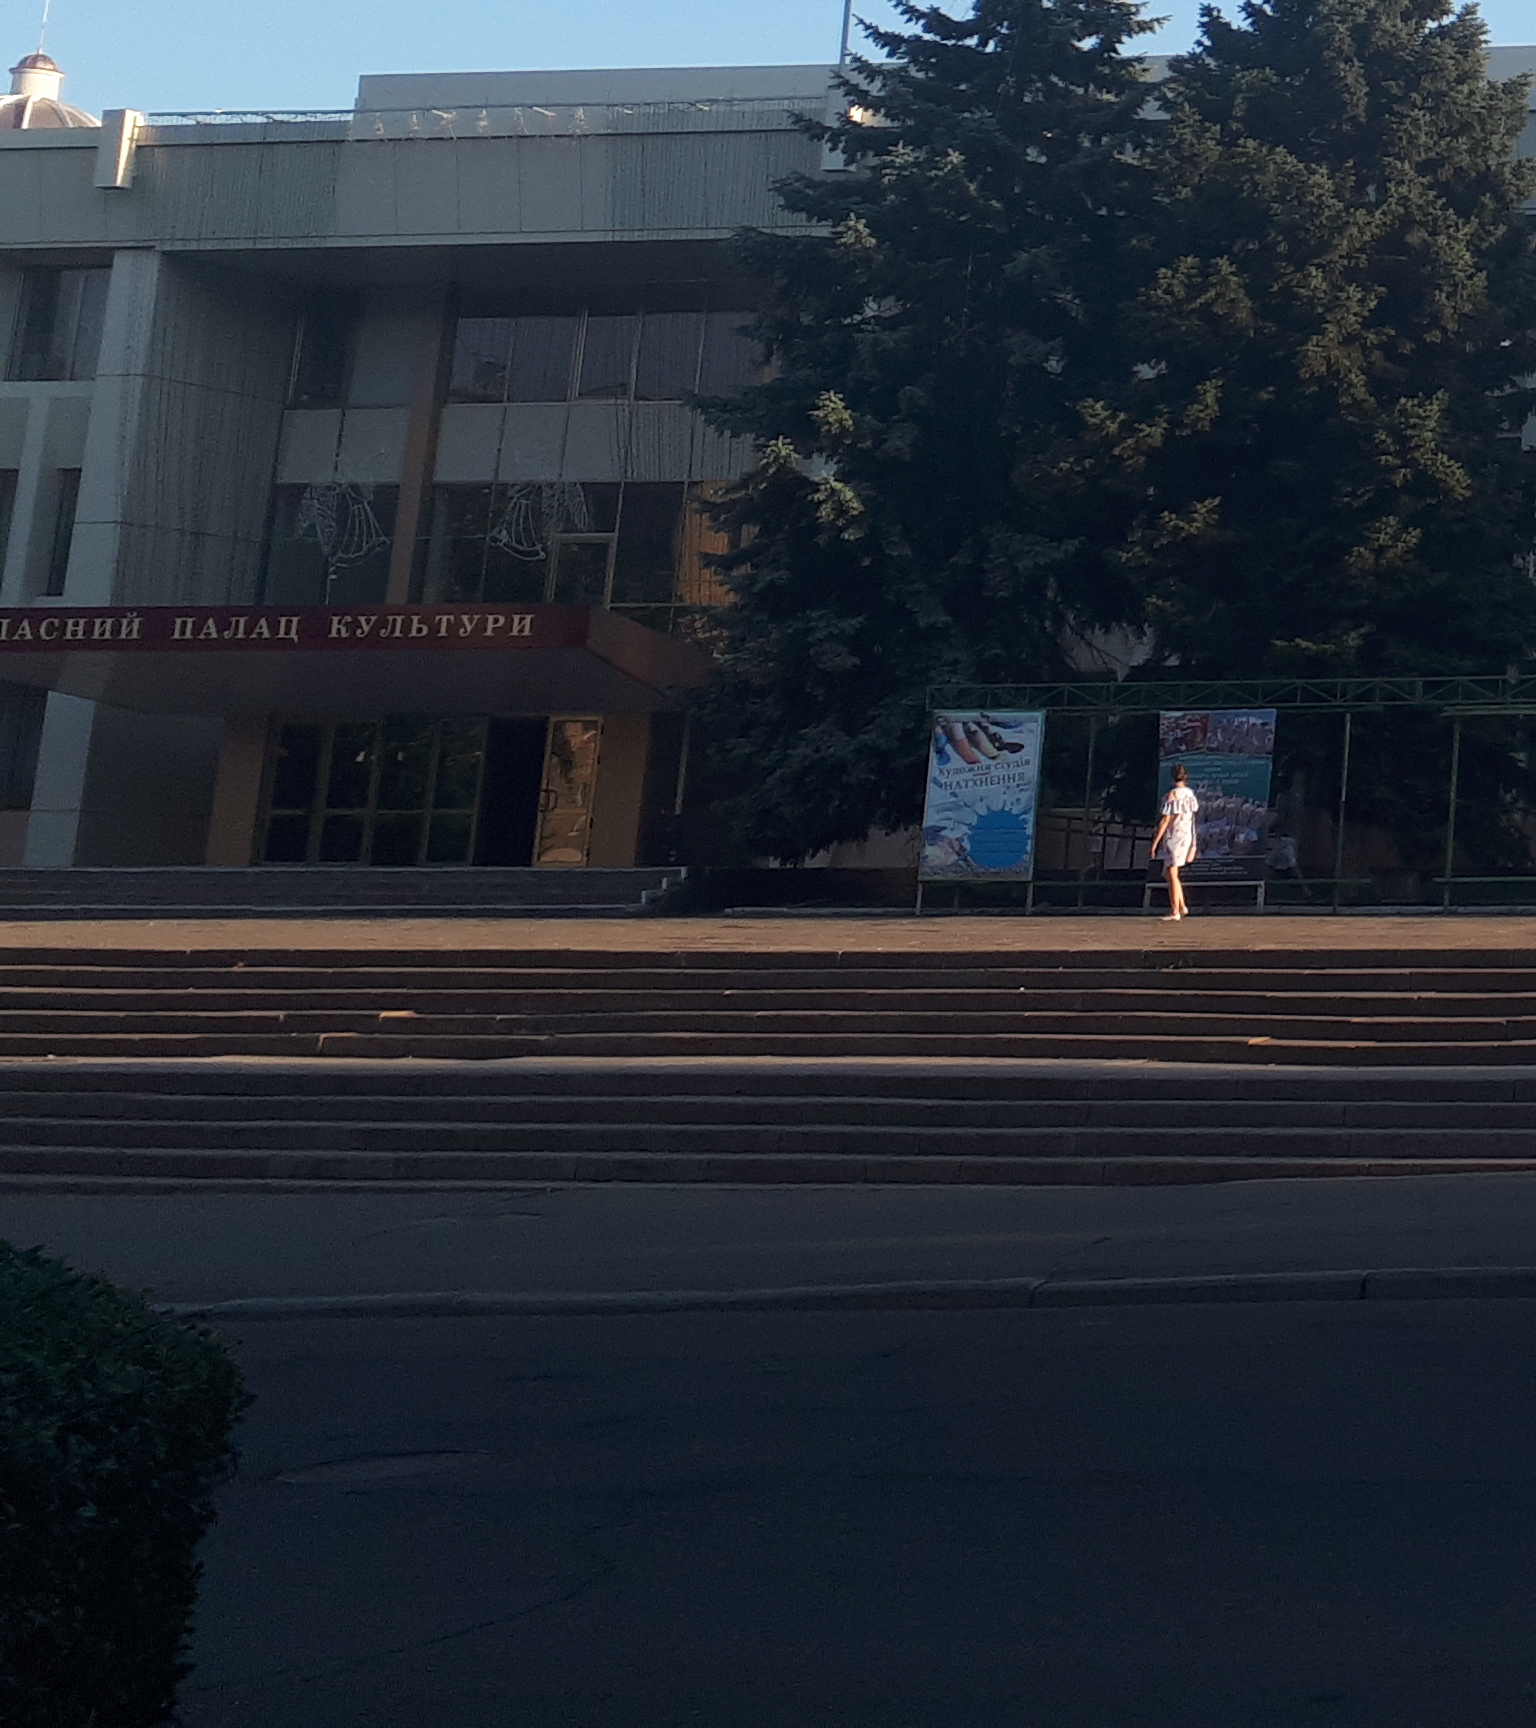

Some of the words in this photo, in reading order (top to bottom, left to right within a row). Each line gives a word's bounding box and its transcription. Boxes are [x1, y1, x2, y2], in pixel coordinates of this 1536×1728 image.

[170, 616, 300, 643] ПАЛАЦ
[328, 613, 536, 638] КУЛЬТУРИ
[944, 772, 1026, 791] НАТХНЕННЯ
